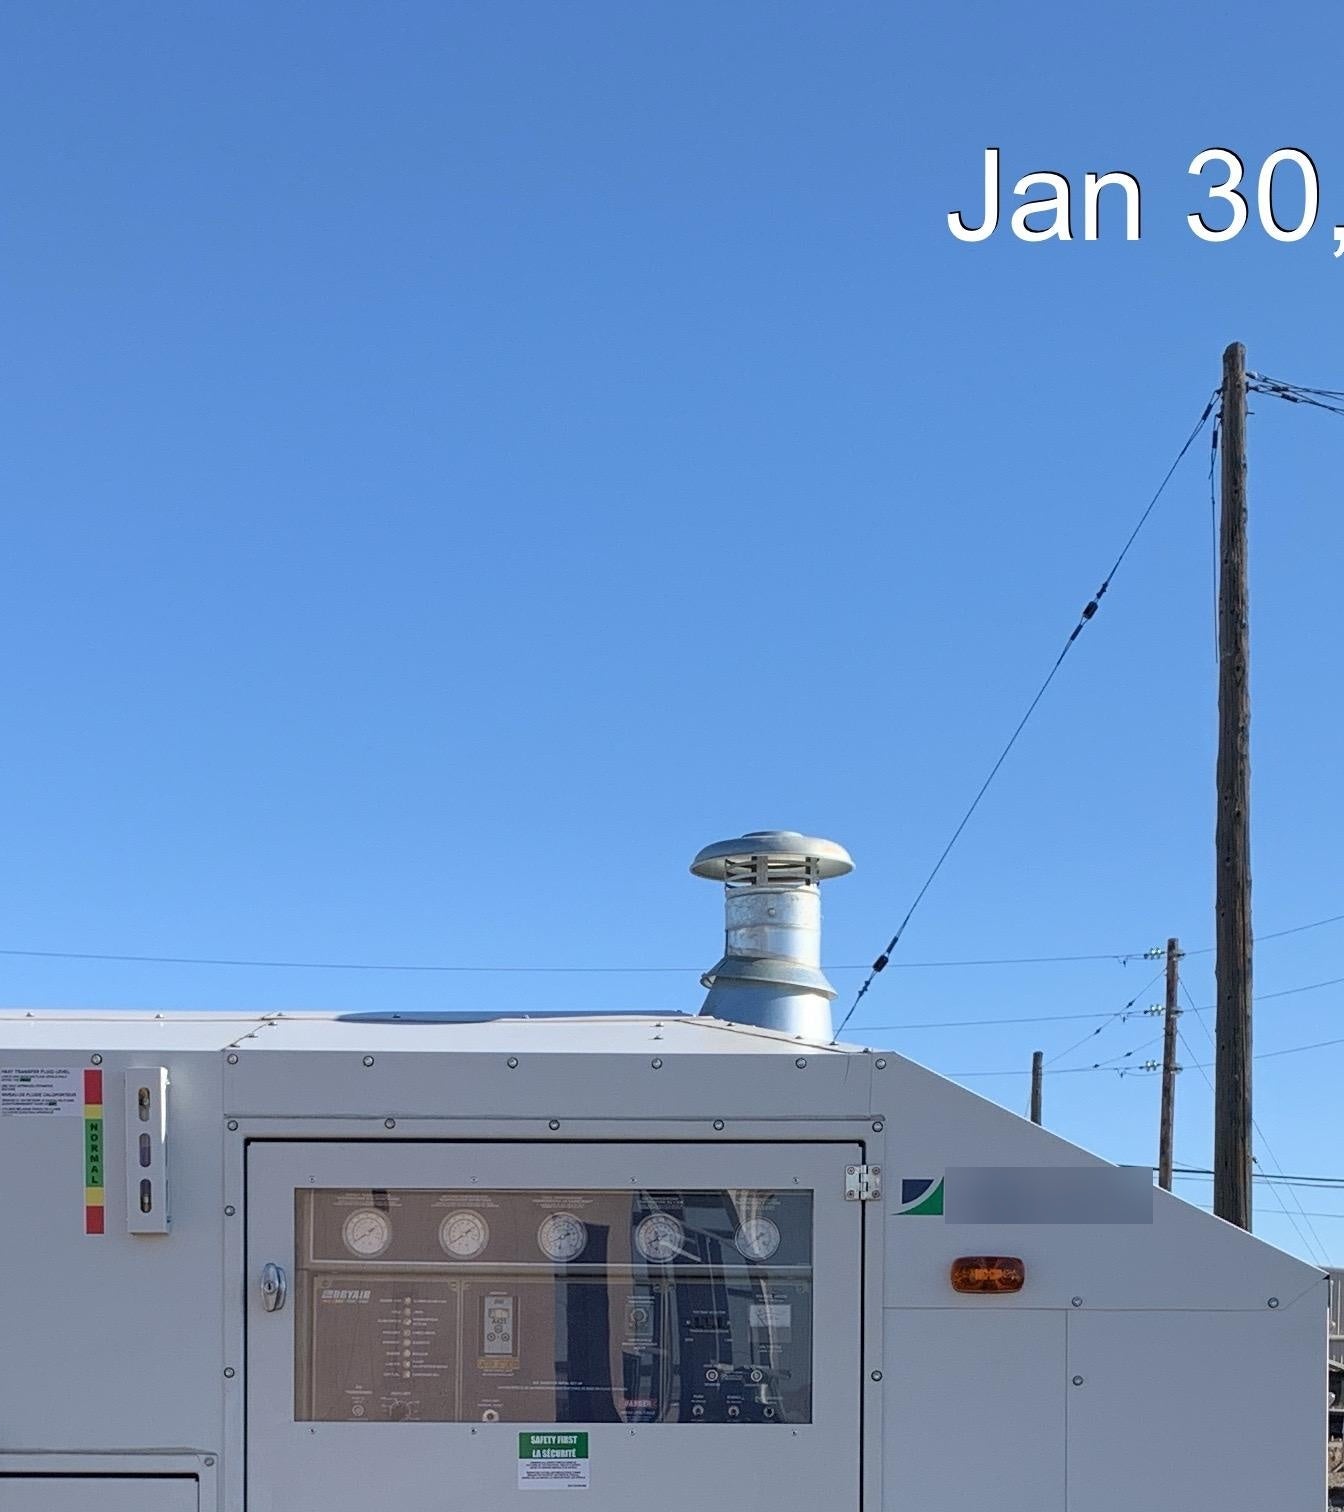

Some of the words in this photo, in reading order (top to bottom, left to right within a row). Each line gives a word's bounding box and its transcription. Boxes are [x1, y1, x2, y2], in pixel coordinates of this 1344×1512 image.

[90, 1123, 99, 1184] NORMAL
[530, 1435, 556, 1445] SAFETY
[557, 1435, 578, 1444] FIRST
[532, 1449, 541, 1458] LA
[542, 1448, 576, 1458] SÉCURITÉ
